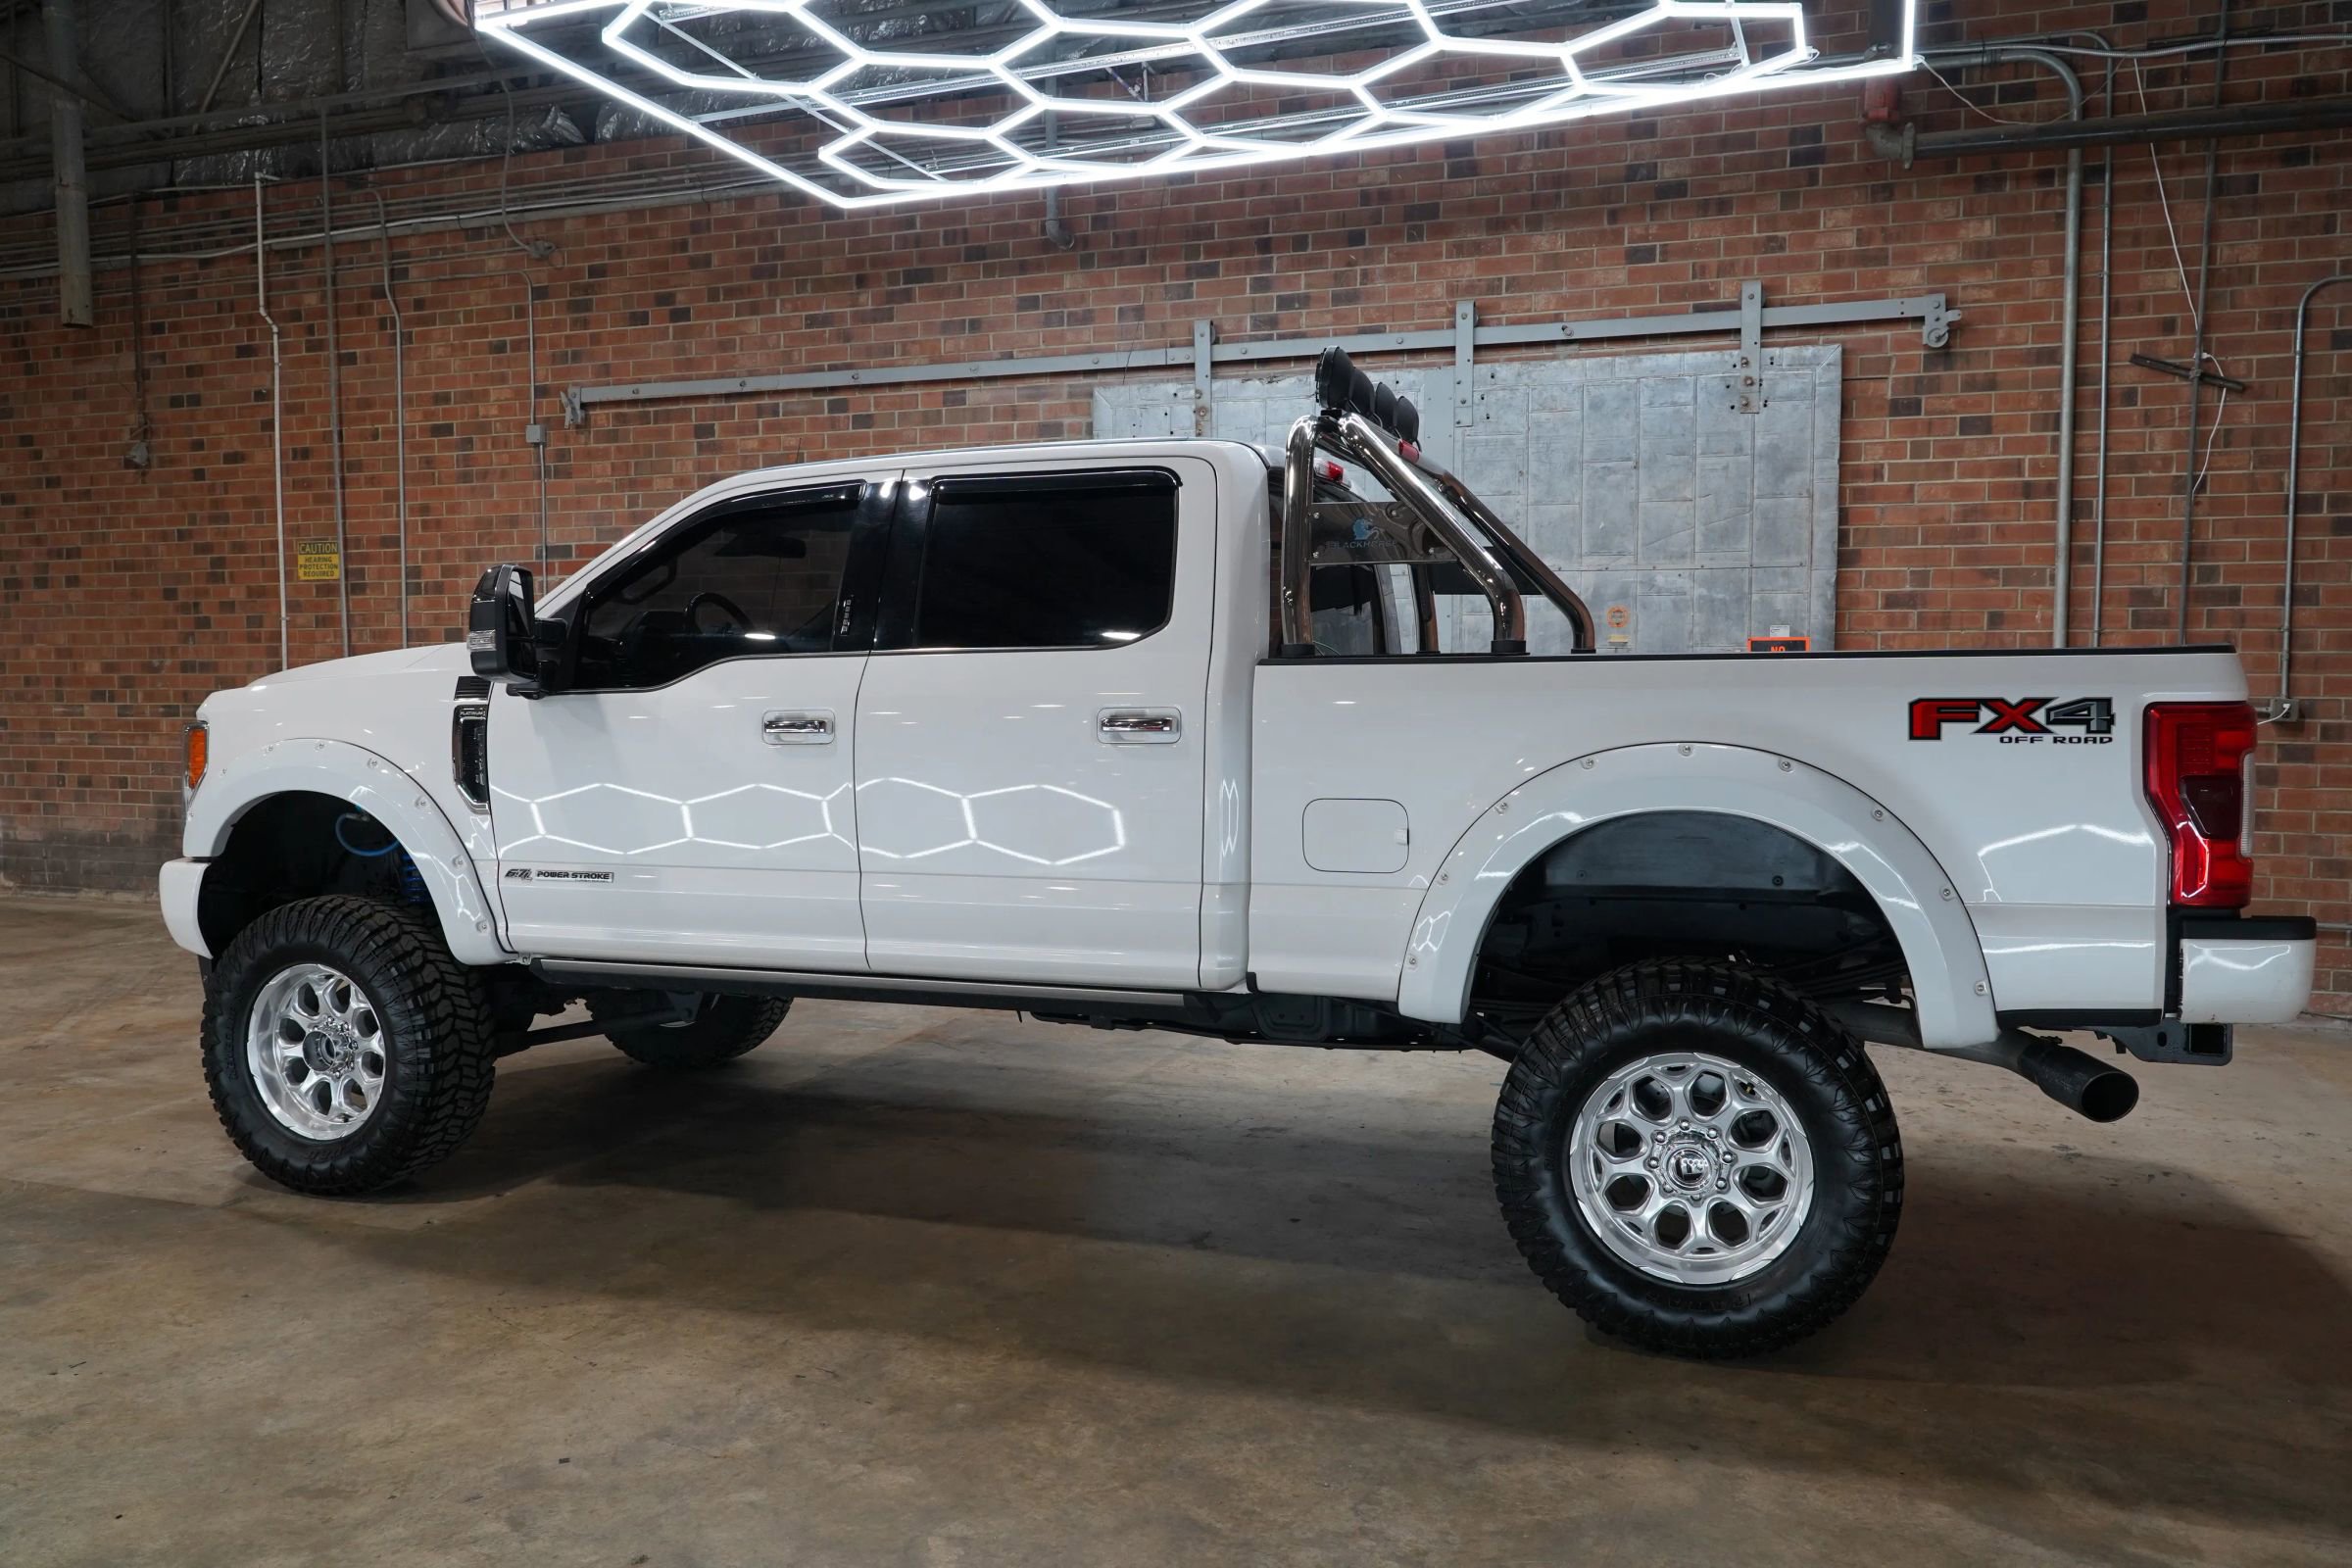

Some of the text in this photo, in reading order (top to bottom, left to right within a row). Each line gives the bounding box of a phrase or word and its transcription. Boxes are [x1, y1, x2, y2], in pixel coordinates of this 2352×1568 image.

[299, 543, 337, 554] CAUTION
[1908, 697, 2115, 740] FX4
[2053, 736, 2113, 745] ROAD
[536, 870, 569, 879] POWER
